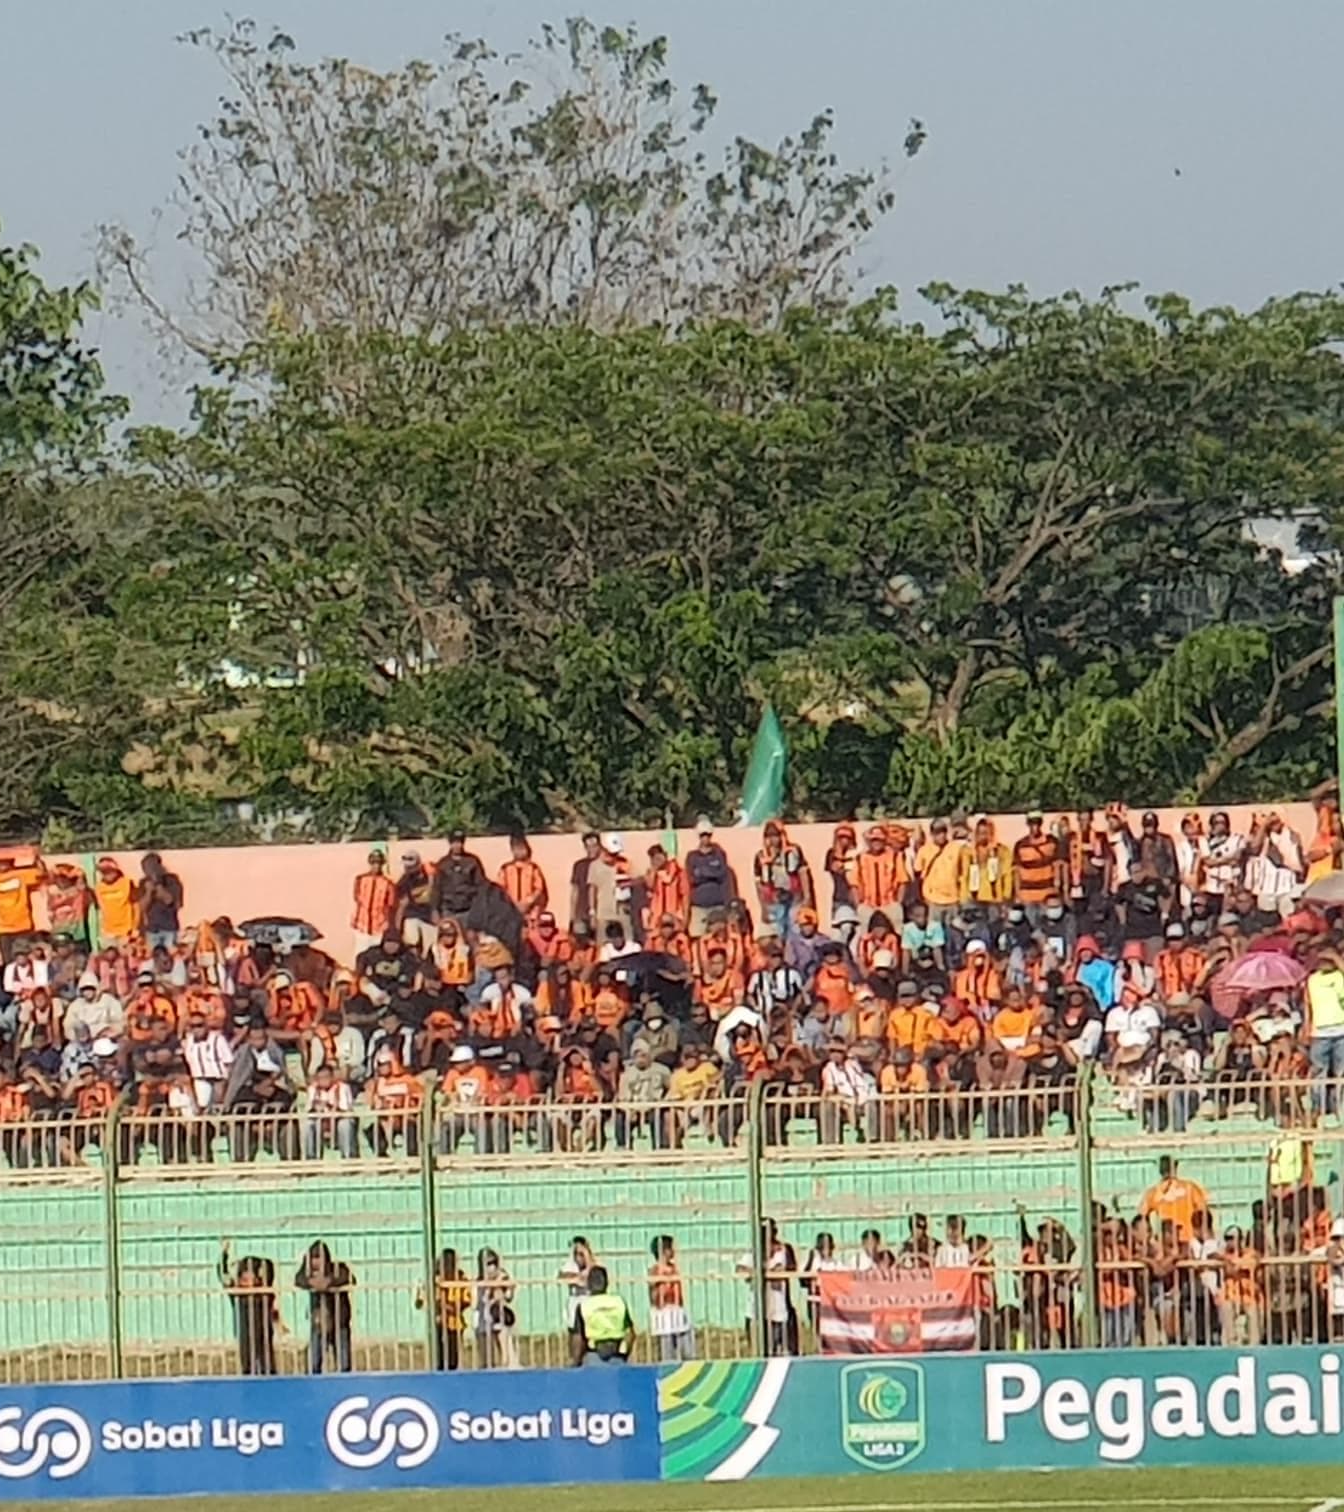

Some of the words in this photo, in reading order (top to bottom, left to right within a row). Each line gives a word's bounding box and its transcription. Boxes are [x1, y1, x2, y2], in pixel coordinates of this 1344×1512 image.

[450, 1408, 552, 1442] Sobat
[562, 1407, 635, 1445] Liga
[983, 1353, 1343, 1461] Pegadai
[101, 1418, 202, 1451] Sobat
[212, 1417, 284, 1455] Liga
